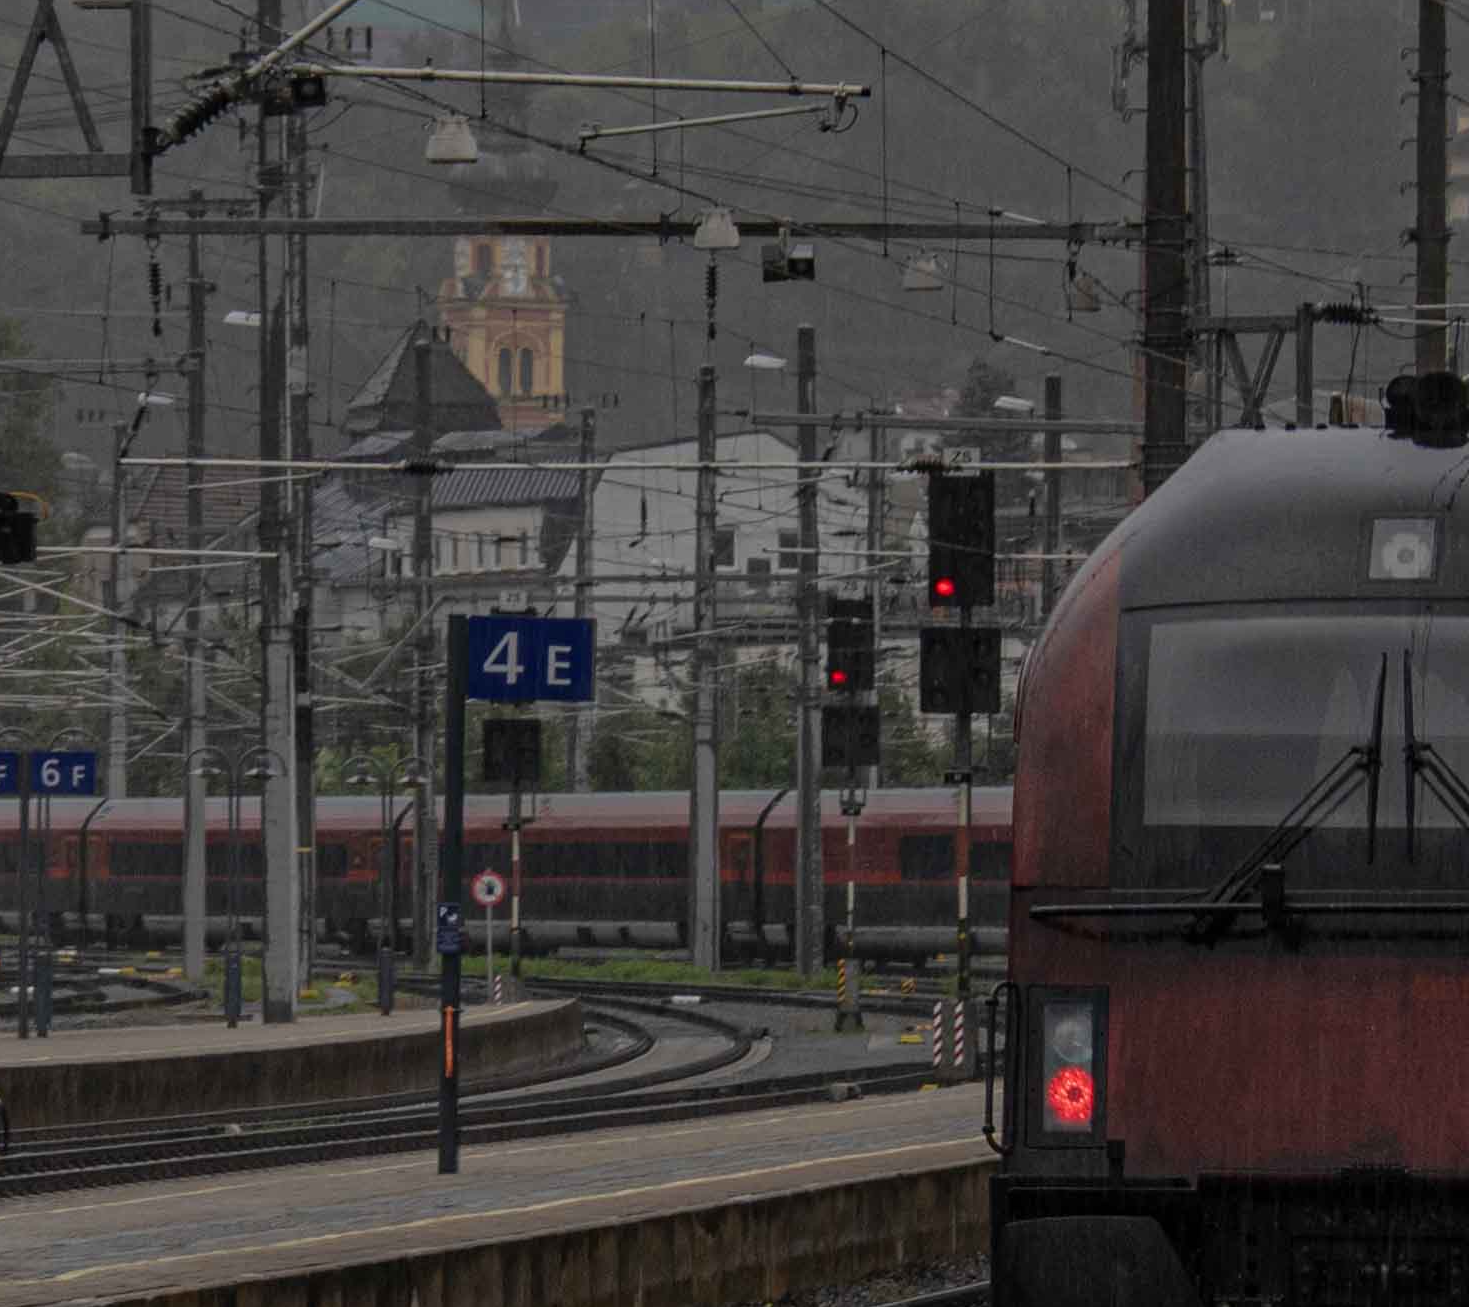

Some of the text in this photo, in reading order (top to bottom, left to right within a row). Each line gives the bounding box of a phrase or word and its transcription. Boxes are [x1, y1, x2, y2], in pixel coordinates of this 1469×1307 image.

[482, 630, 573, 687] 4 E
[40, 757, 87, 789] 6 F
